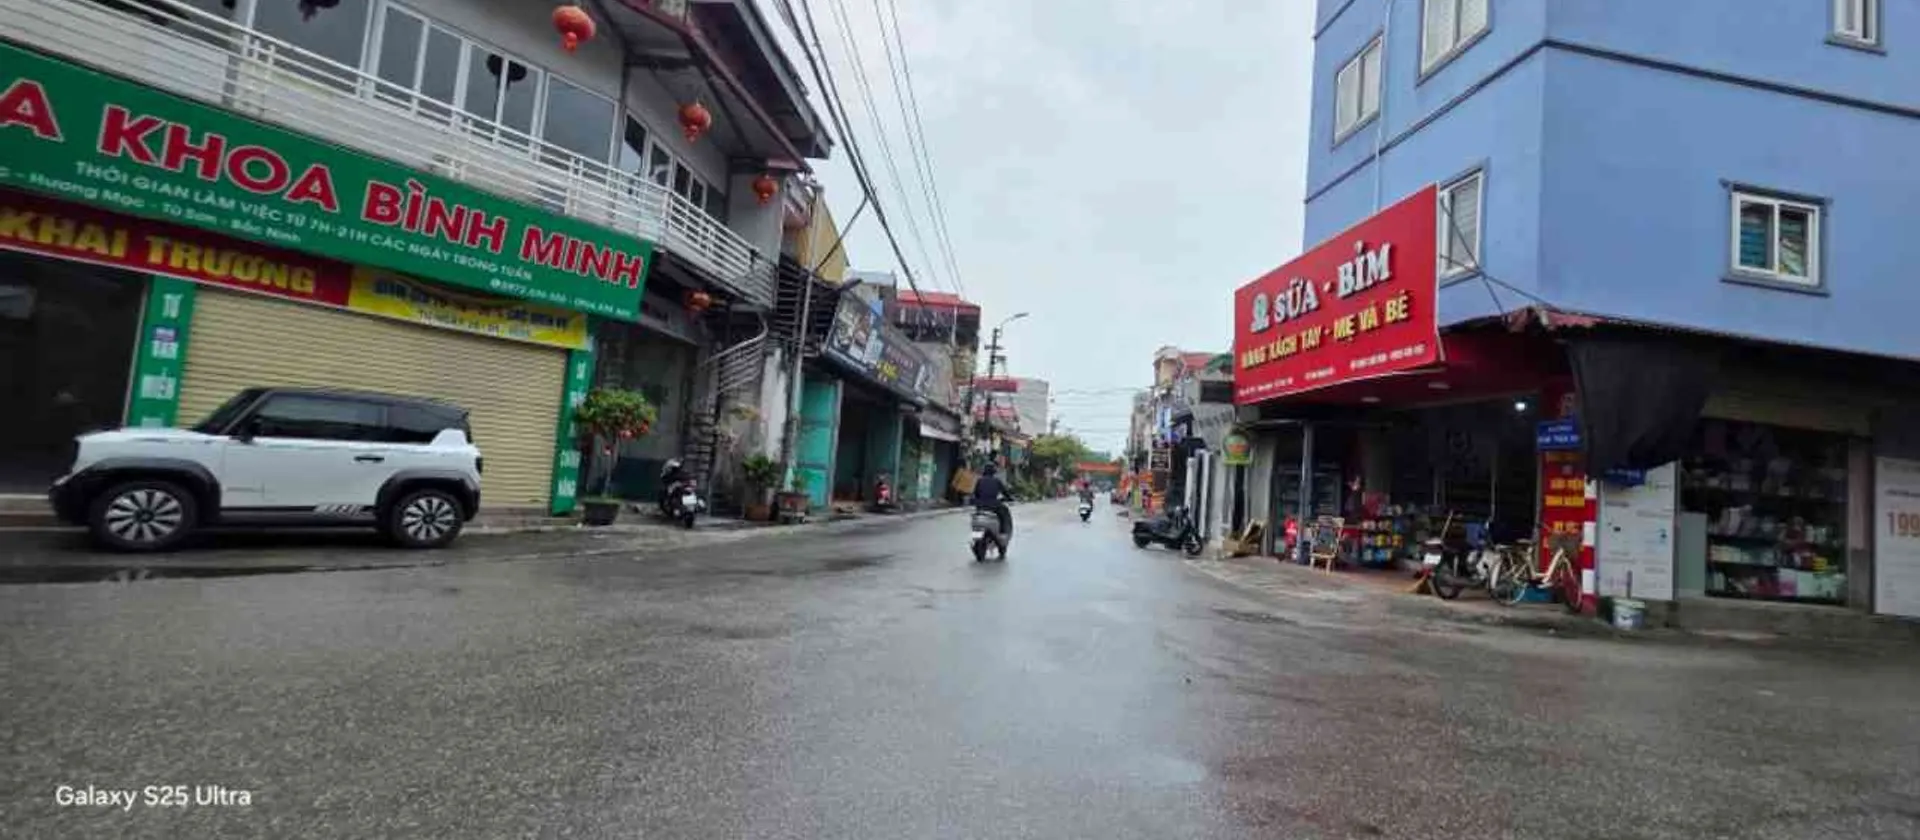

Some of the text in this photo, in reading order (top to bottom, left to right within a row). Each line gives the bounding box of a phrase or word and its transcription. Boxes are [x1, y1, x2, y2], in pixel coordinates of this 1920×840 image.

[76, 161, 128, 186] THỜI
[132, 176, 189, 200] GIAN
[193, 189, 235, 211] LÀM
[369, 232, 406, 252] CÁC
[97, 103, 340, 213] KHOA
[361, 178, 507, 254] BÌNH
[520, 224, 643, 289] MINH
[1273, 240, 1392, 324] SỮA BỈM
[1333, 313, 1356, 343] MẸ
[1384, 290, 1408, 324] BÉ
